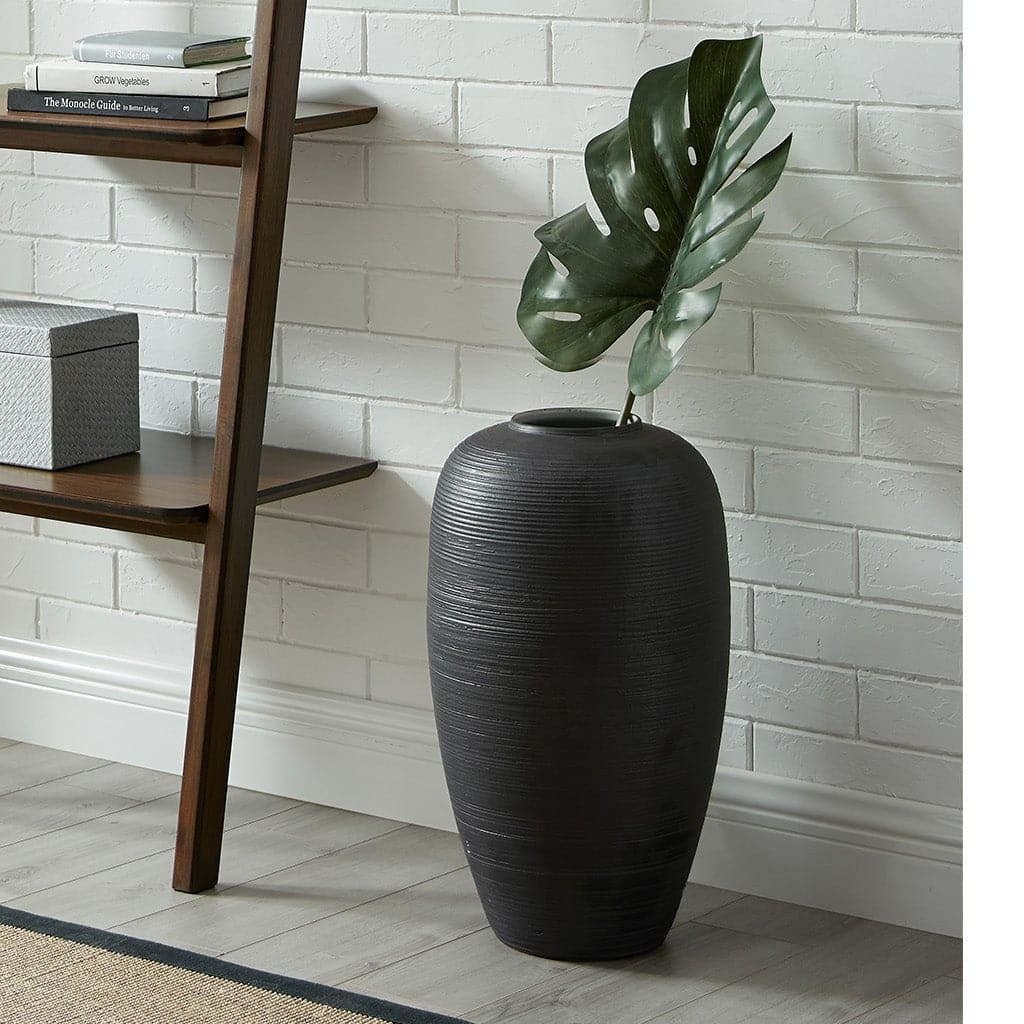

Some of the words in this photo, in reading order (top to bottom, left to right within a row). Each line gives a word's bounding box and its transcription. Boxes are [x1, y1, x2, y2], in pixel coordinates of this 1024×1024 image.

[94, 76, 116, 85] GROW
[117, 77, 150, 87] Vegetables
[44, 97, 60, 107] The
[61, 98, 95, 109] Monocle
[96, 99, 121, 111] Guide
[144, 106, 159, 114] Living
